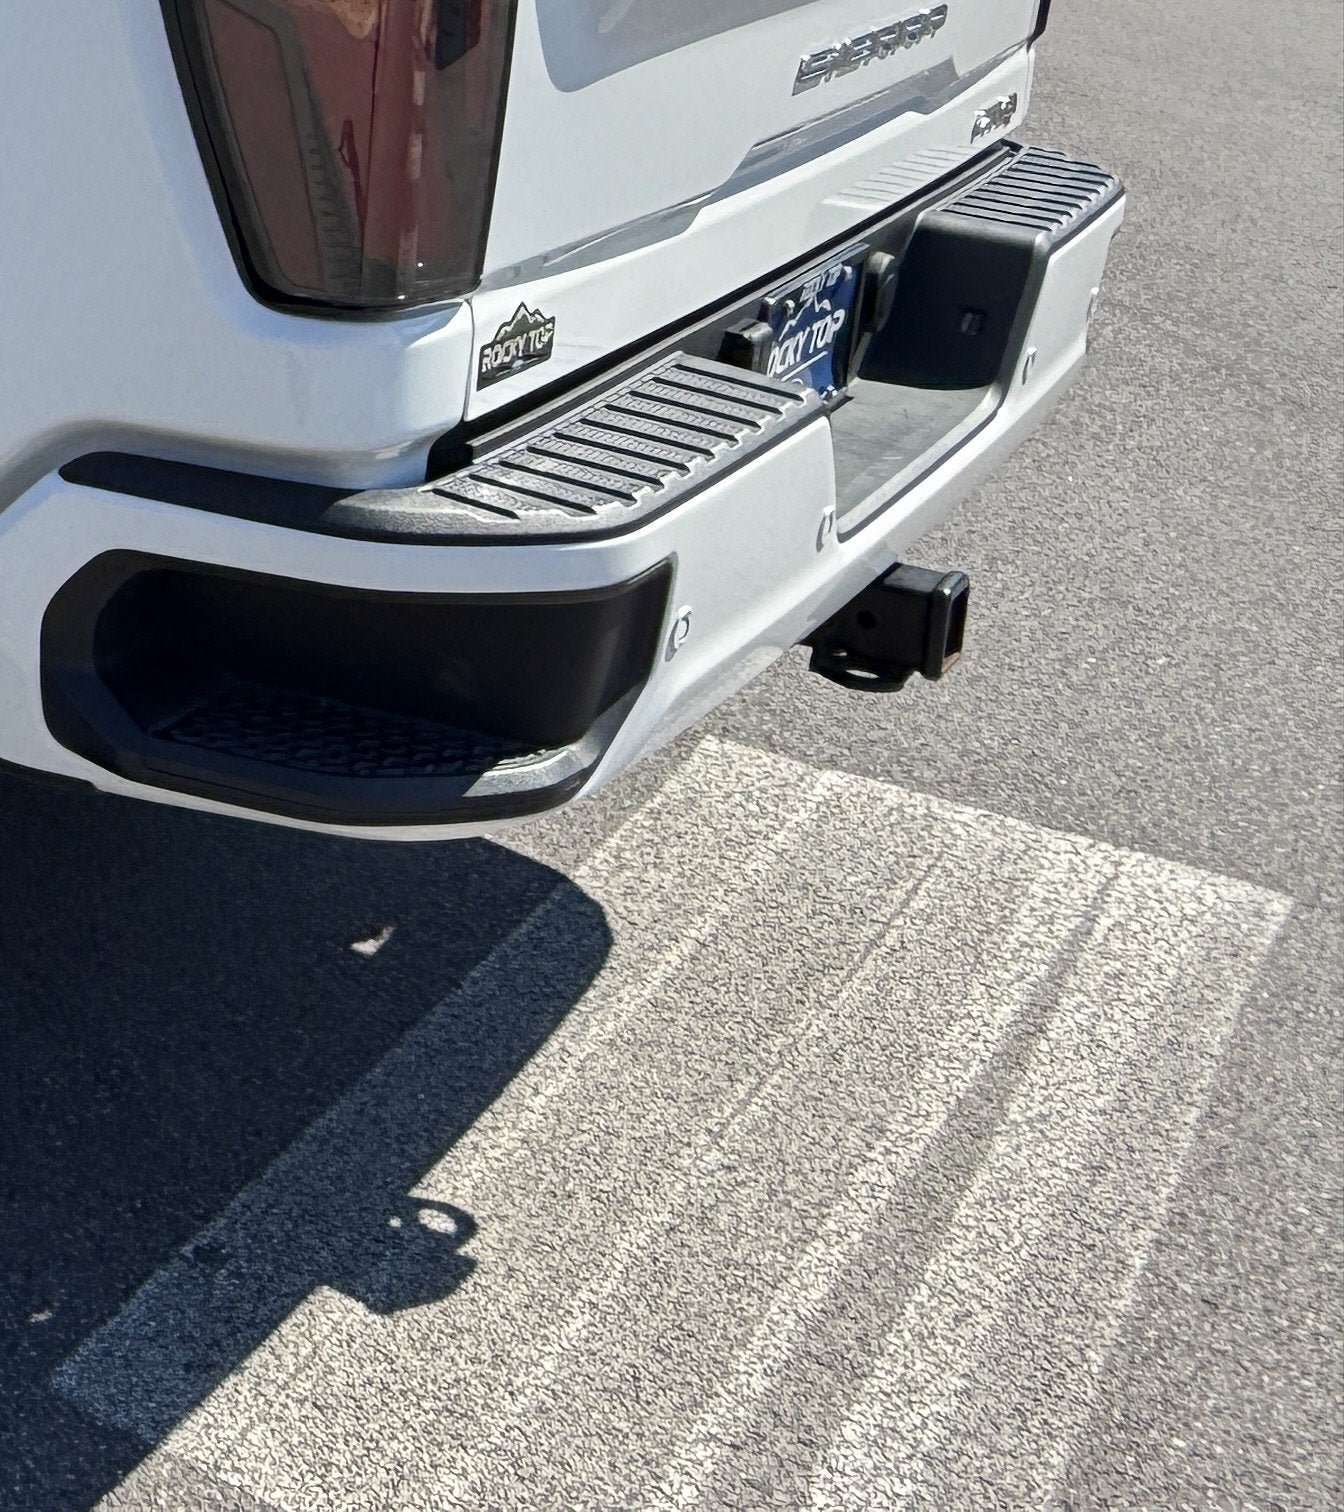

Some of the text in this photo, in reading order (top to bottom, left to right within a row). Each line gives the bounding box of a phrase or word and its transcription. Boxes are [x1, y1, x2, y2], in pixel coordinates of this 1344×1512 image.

[481, 333, 528, 373] ROCKY
[767, 309, 845, 378] OCKY TOP
